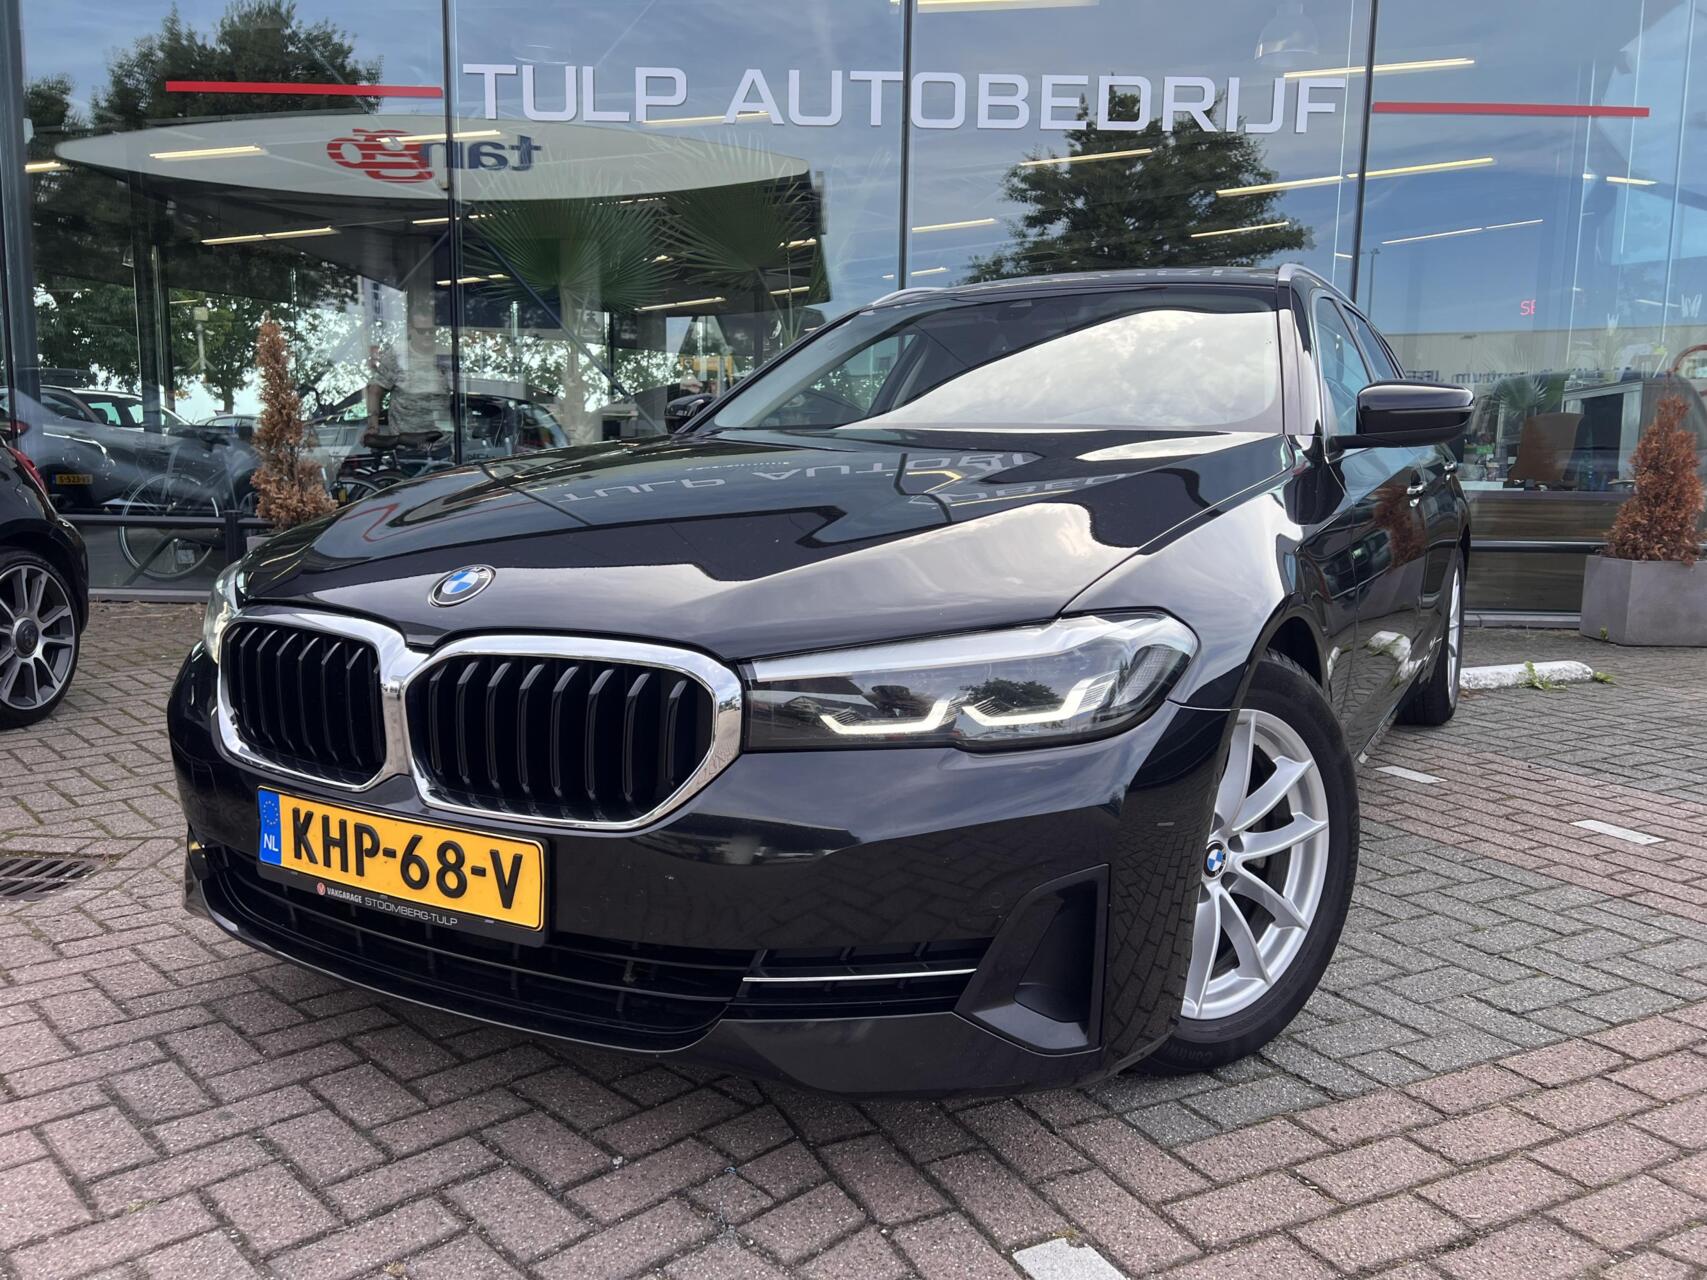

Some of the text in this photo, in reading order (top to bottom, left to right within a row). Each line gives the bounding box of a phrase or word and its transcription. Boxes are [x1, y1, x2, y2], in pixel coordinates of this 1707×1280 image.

[462, 63, 1346, 134] TULP AUTOBEDRIJF
[263, 833, 280, 852] NL
[291, 807, 523, 910] KHP-68-V
[327, 886, 458, 926] VAKGARAGE STOOMBERG-TULP
